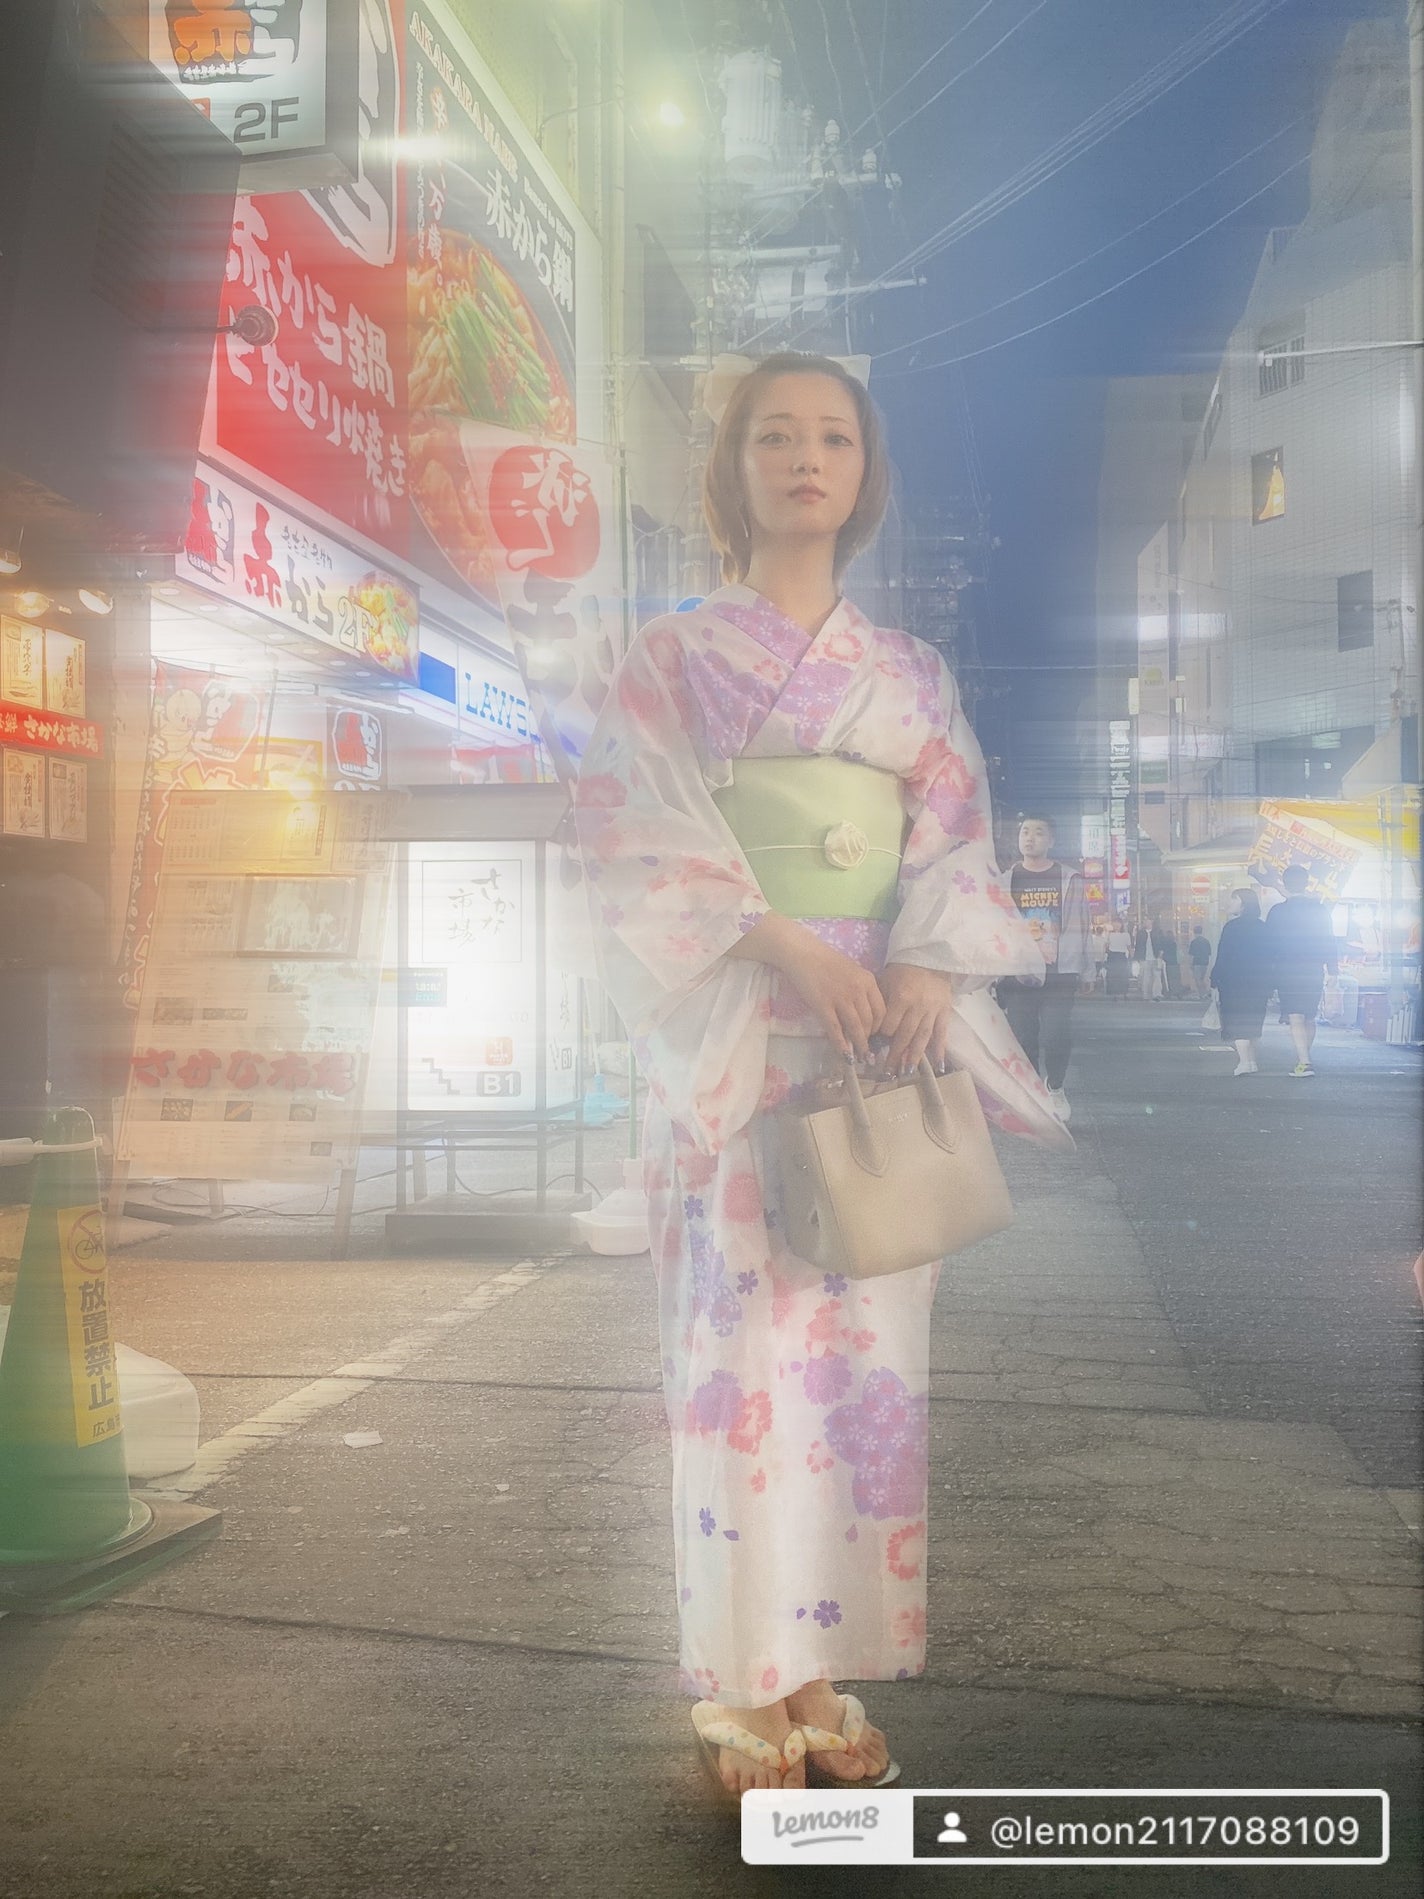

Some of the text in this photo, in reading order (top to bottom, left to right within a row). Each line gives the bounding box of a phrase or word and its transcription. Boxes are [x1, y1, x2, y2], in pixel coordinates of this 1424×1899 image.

[234, 97, 299, 144] 2F
[486, 168, 573, 312] 赤から鍋
[226, 195, 395, 408] 赤から鍋
[244, 502, 334, 637] 赤から
[23, 713, 99, 753] さかな市場
[1021, 892, 1059, 901] MICKEY
[1021, 900, 1059, 908] MOUSE
[130, 1048, 356, 1095] さかな市場
[483, 1072, 515, 1096] B1
[79, 1279, 114, 1411] 放置禁止
